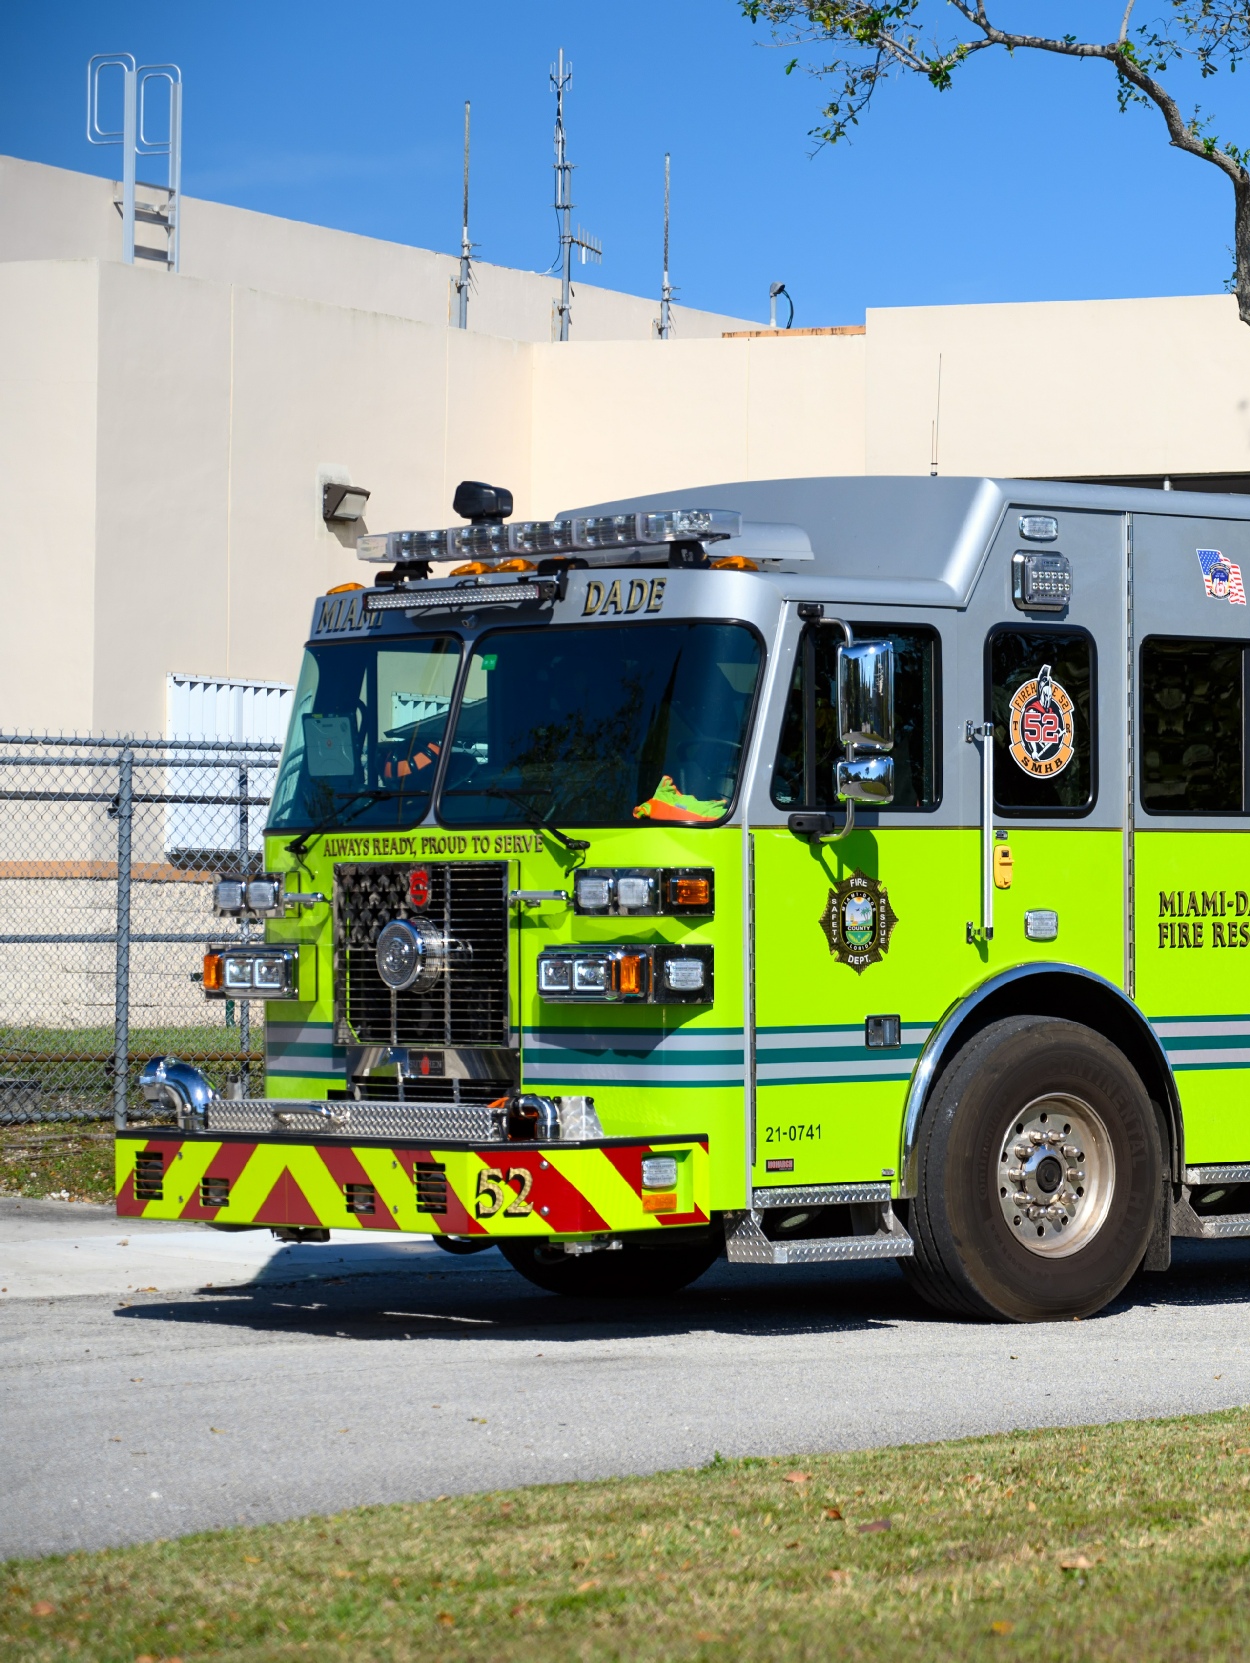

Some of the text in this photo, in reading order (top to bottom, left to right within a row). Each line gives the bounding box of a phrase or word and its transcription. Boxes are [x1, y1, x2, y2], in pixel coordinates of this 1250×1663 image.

[315, 577, 667, 634] MIAMI DADE
[1014, 682, 1069, 710] FIREHE 52
[1024, 712, 1060, 744] 52
[1021, 756, 1063, 774] SMHB
[323, 834, 544, 858] ALWAYS READY, PROUD TO SERVE
[850, 878, 868, 887] FIRE
[1158, 922, 1204, 948] FIRE
[765, 1123, 821, 1142] 21-0741
[475, 1167, 534, 1219] 52
